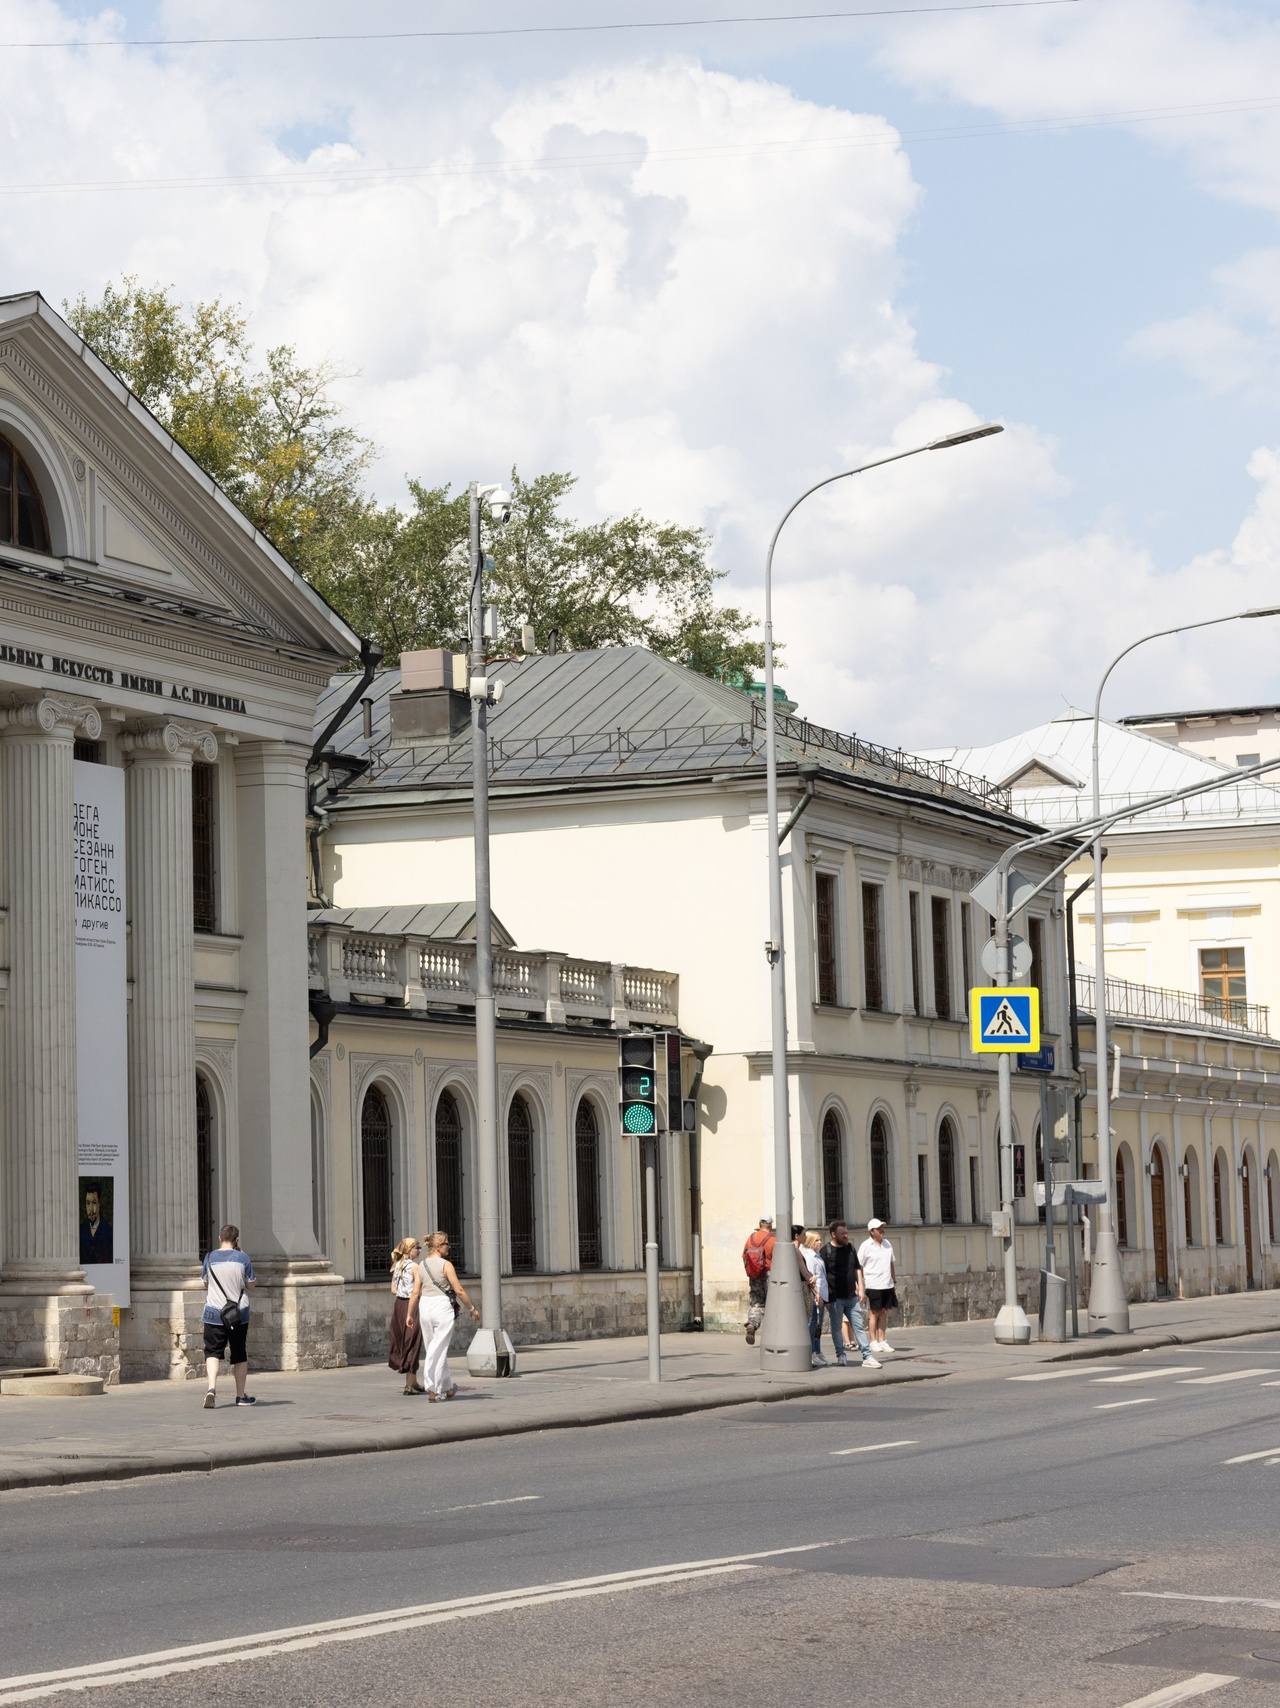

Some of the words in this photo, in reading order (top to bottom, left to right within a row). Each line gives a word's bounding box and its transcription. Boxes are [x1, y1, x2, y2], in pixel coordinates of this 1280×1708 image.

[52, 656, 114, 684] ИСКУССТВ
[120, 673, 163, 695] ИМЕНИ
[171, 683, 247, 714] А.С.ПУШКИНА
[74, 856, 107, 875] ОГЕН
[82, 919, 109, 930] другие
[640, 1077, 650, 1096] 2
